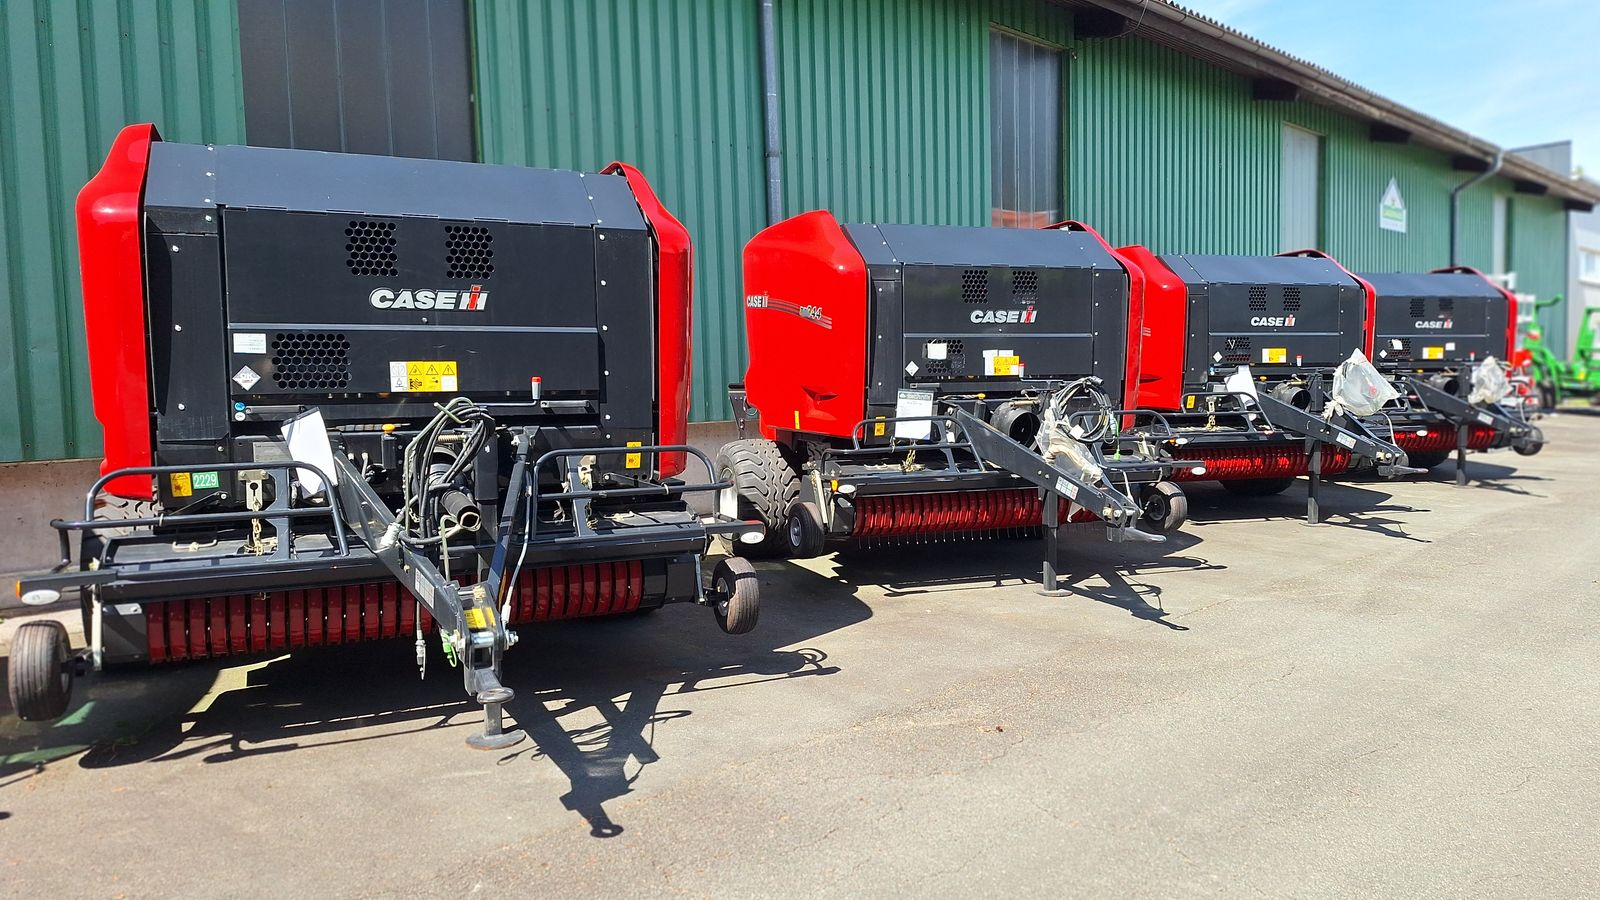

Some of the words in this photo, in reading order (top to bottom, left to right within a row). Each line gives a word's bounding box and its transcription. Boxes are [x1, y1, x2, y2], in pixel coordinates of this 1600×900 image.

[369, 287, 458, 310] CASE
[746, 295, 762, 308] CASE
[970, 310, 1019, 323] CASE
[1250, 316, 1284, 327] CASE
[1415, 320, 1443, 329] CASE
[193, 473, 217, 487] 2229
